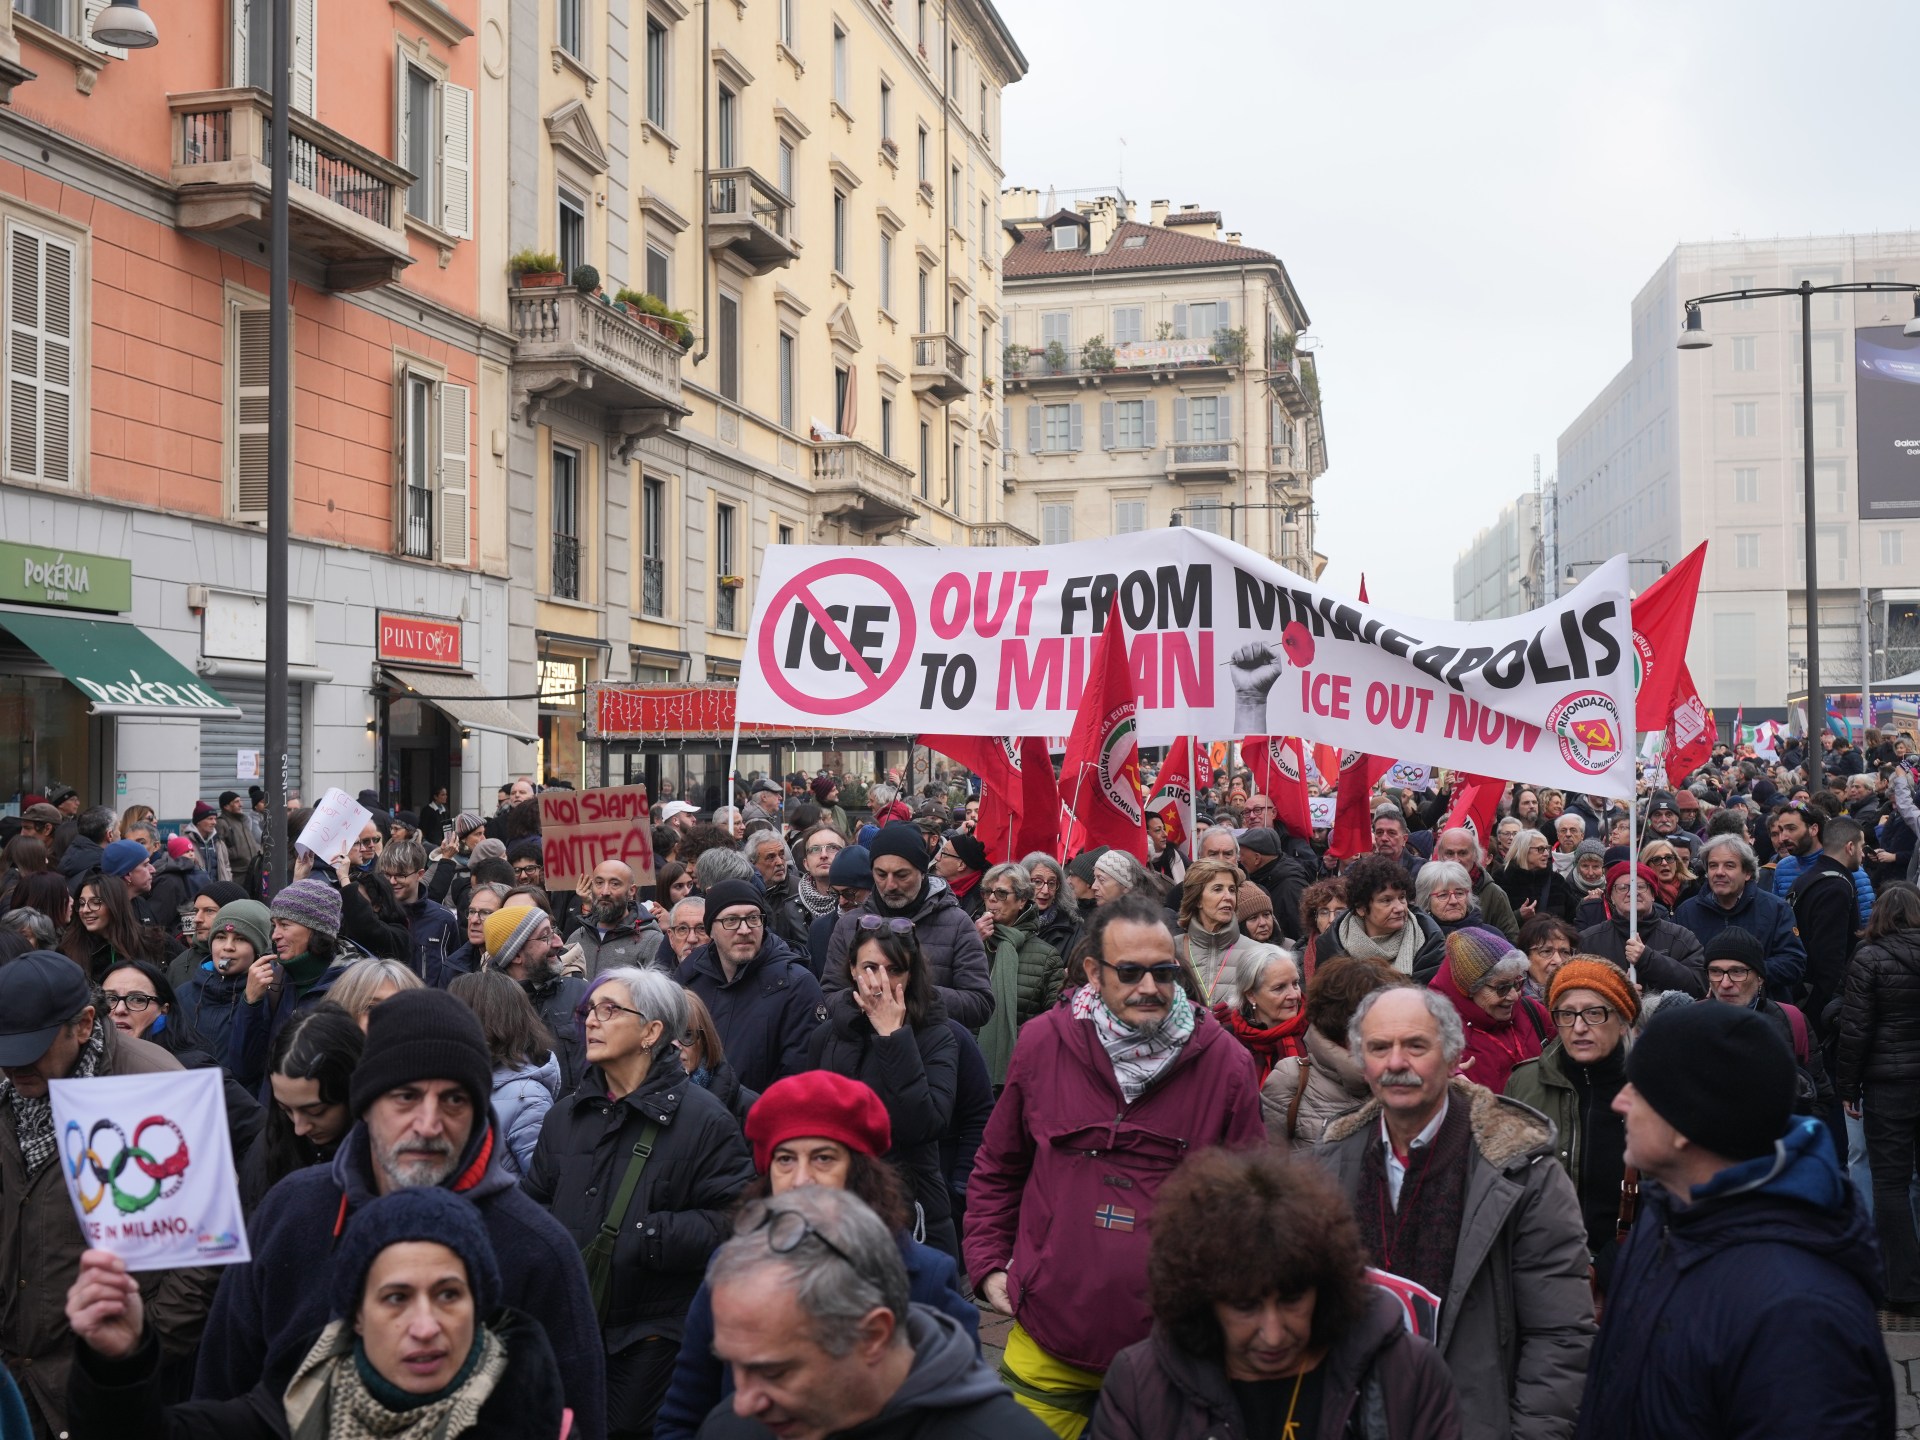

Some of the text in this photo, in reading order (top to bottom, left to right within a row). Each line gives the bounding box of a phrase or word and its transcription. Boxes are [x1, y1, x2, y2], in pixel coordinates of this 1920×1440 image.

[24, 552, 90, 593] POKÉRIA
[930, 569, 1050, 640] OUT
[1061, 563, 1213, 635] FROM
[384, 626, 435, 651] PUNTO
[784, 602, 891, 674] ICE
[920, 653, 977, 711] TO
[1301, 670, 1542, 752] ICE OUT NOW
[1557, 697, 1620, 728] RIFONDAZIONE
[1100, 753, 1112, 791] PARTITO
[1571, 745, 1621, 769] PARTITO COMUNISTA
[320, 805, 340, 818] NOT
[333, 790, 352, 808] ICE
[581, 793, 650, 820] SIAMO
[543, 828, 653, 879] ANTIFA
[121, 1217, 194, 1239] MILANO.
